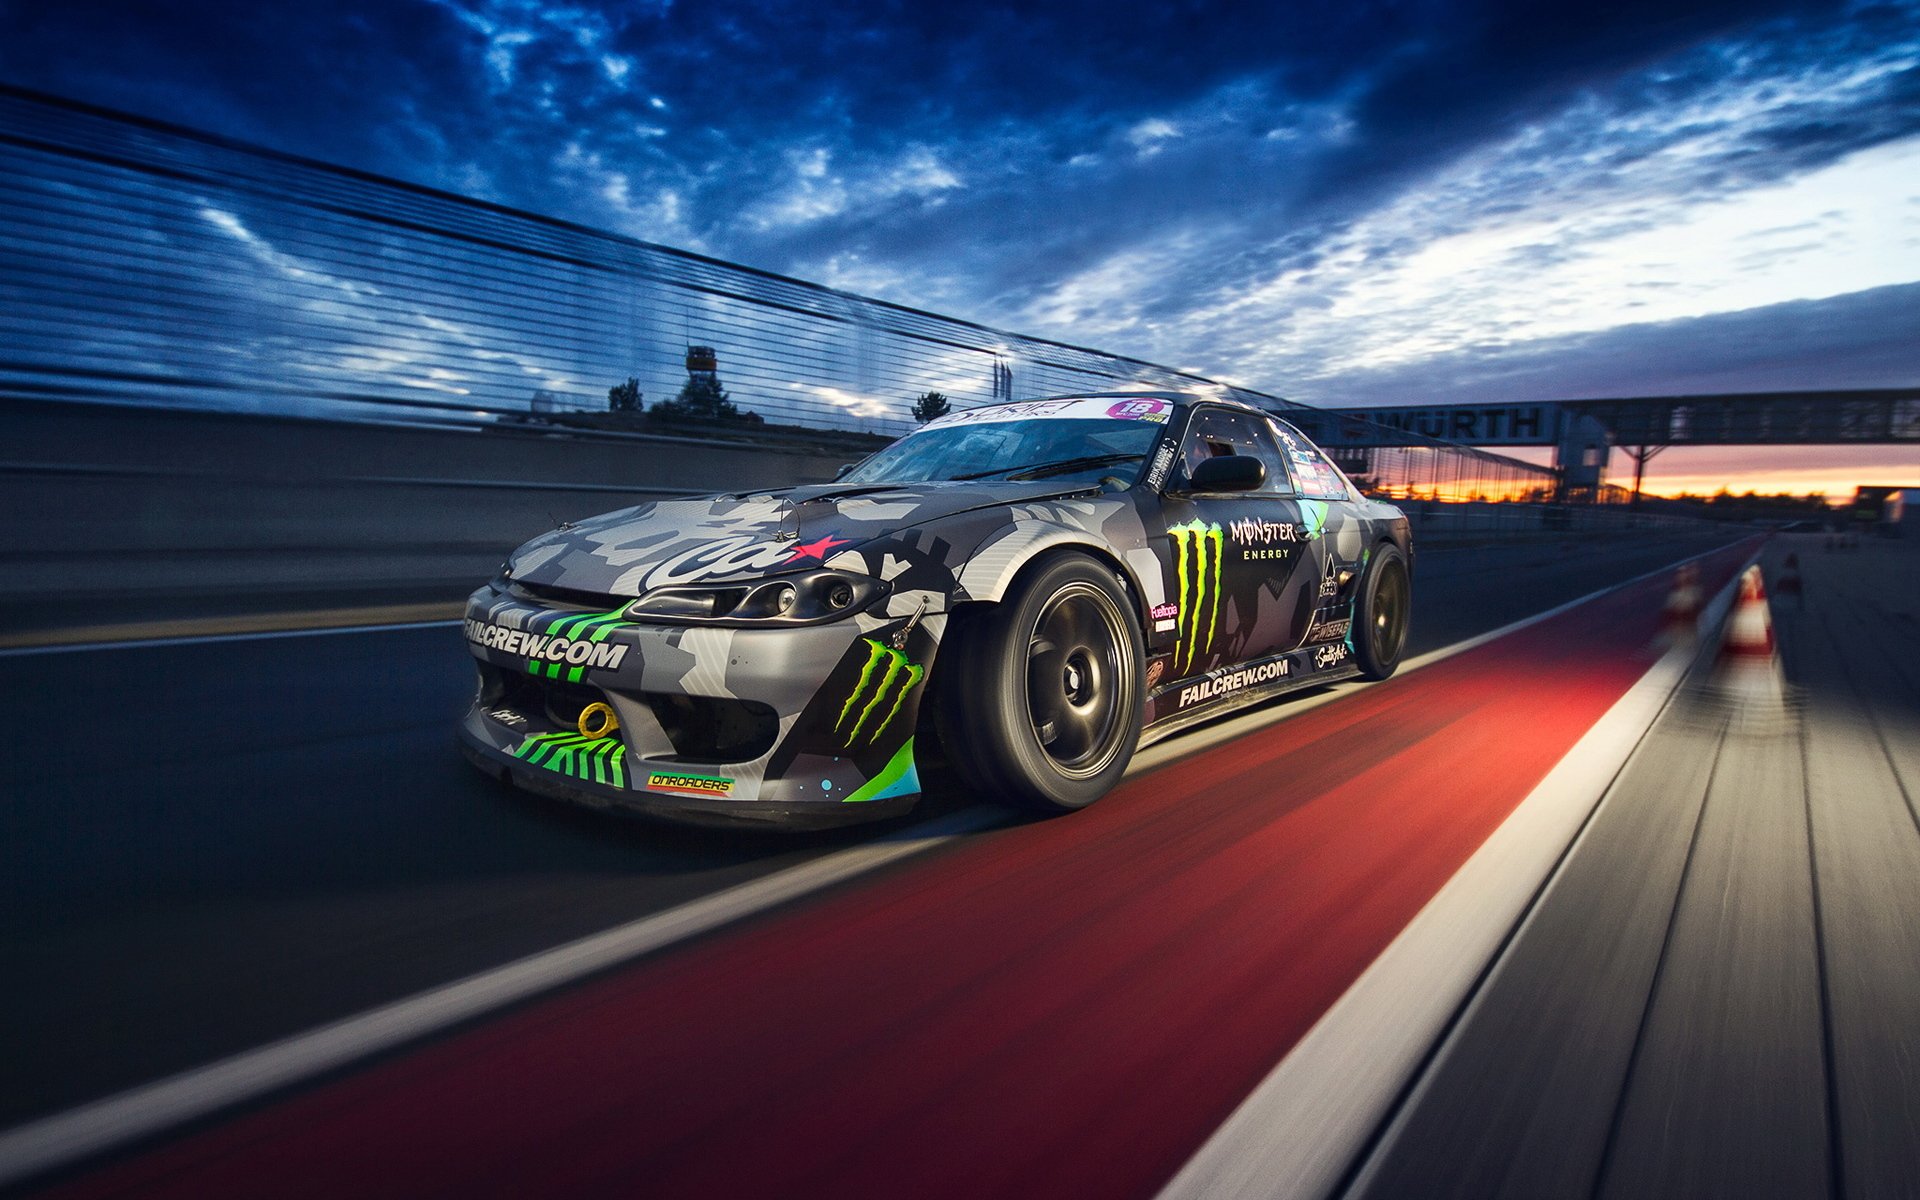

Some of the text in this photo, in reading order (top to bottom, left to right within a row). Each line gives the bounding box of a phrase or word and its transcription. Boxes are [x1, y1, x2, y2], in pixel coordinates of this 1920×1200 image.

[1120, 402, 1154, 413] 18
[1374, 408, 1542, 440] WÜRTH
[1229, 515, 1297, 546] MONSTER
[1243, 549, 1289, 560] ENERGY
[465, 618, 629, 669] FAILCREW.COM
[1178, 659, 1289, 709] FAILCREW.COM
